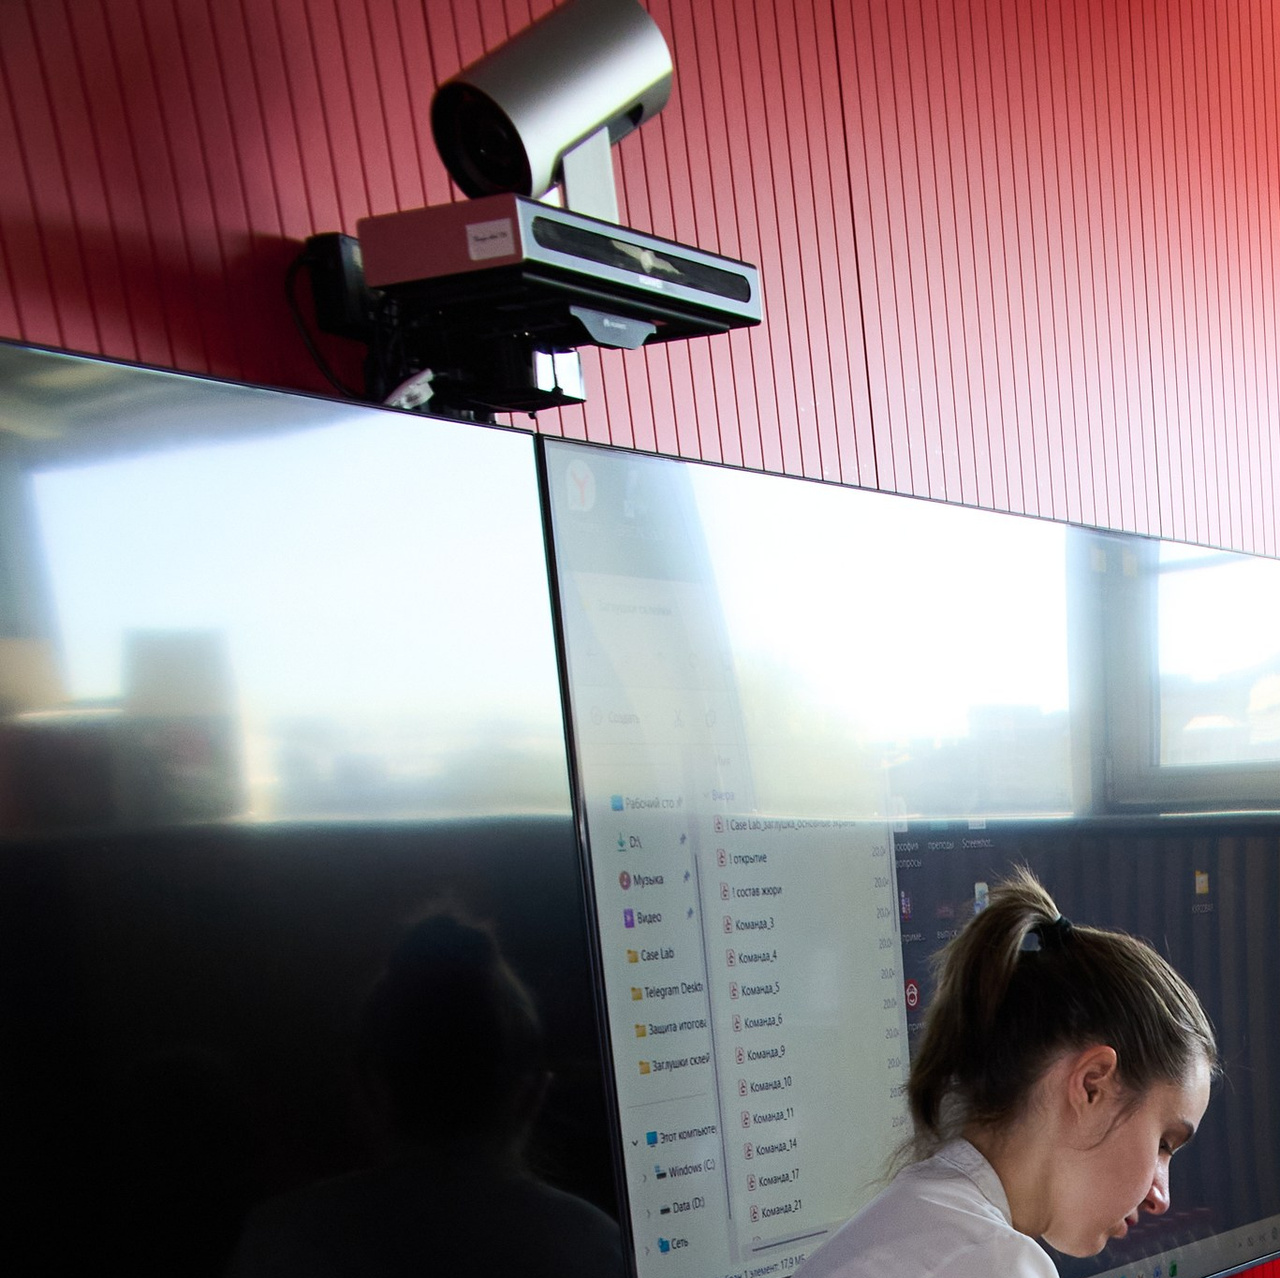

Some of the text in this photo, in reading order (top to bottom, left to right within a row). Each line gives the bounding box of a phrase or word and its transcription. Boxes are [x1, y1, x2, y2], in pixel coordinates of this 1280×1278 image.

[733, 853, 767, 866] открытие
[633, 874, 664, 888] Музыка
[736, 886, 760, 898] состав
[761, 885, 782, 898] жюри
[637, 912, 662, 924] Видео
[736, 917, 775, 931] Команда_3
[641, 948, 675, 962] Case Lab
[739, 950, 778, 964] Команда_4
[645, 985, 680, 1000] Telegram
[741, 982, 780, 996] Команда_5
[744, 1013, 783, 1028] Команда_6
[648, 1022, 677, 1036] Защита
[747, 1045, 786, 1061] Команда_9
[652, 1058, 689, 1073] Заглушки
[750, 1076, 792, 1093] Команда_10
[753, 1107, 794, 1124] Команда_11
[660, 1131, 677, 1144] Этот
[756, 1138, 797, 1156] Команда_14
[669, 1162, 702, 1178] Windows
[758, 1168, 800, 1187] Команда_17
[673, 1200, 690, 1214] Data
[761, 1199, 802, 1219] Команда_21
[671, 1237, 689, 1249] Сеть
